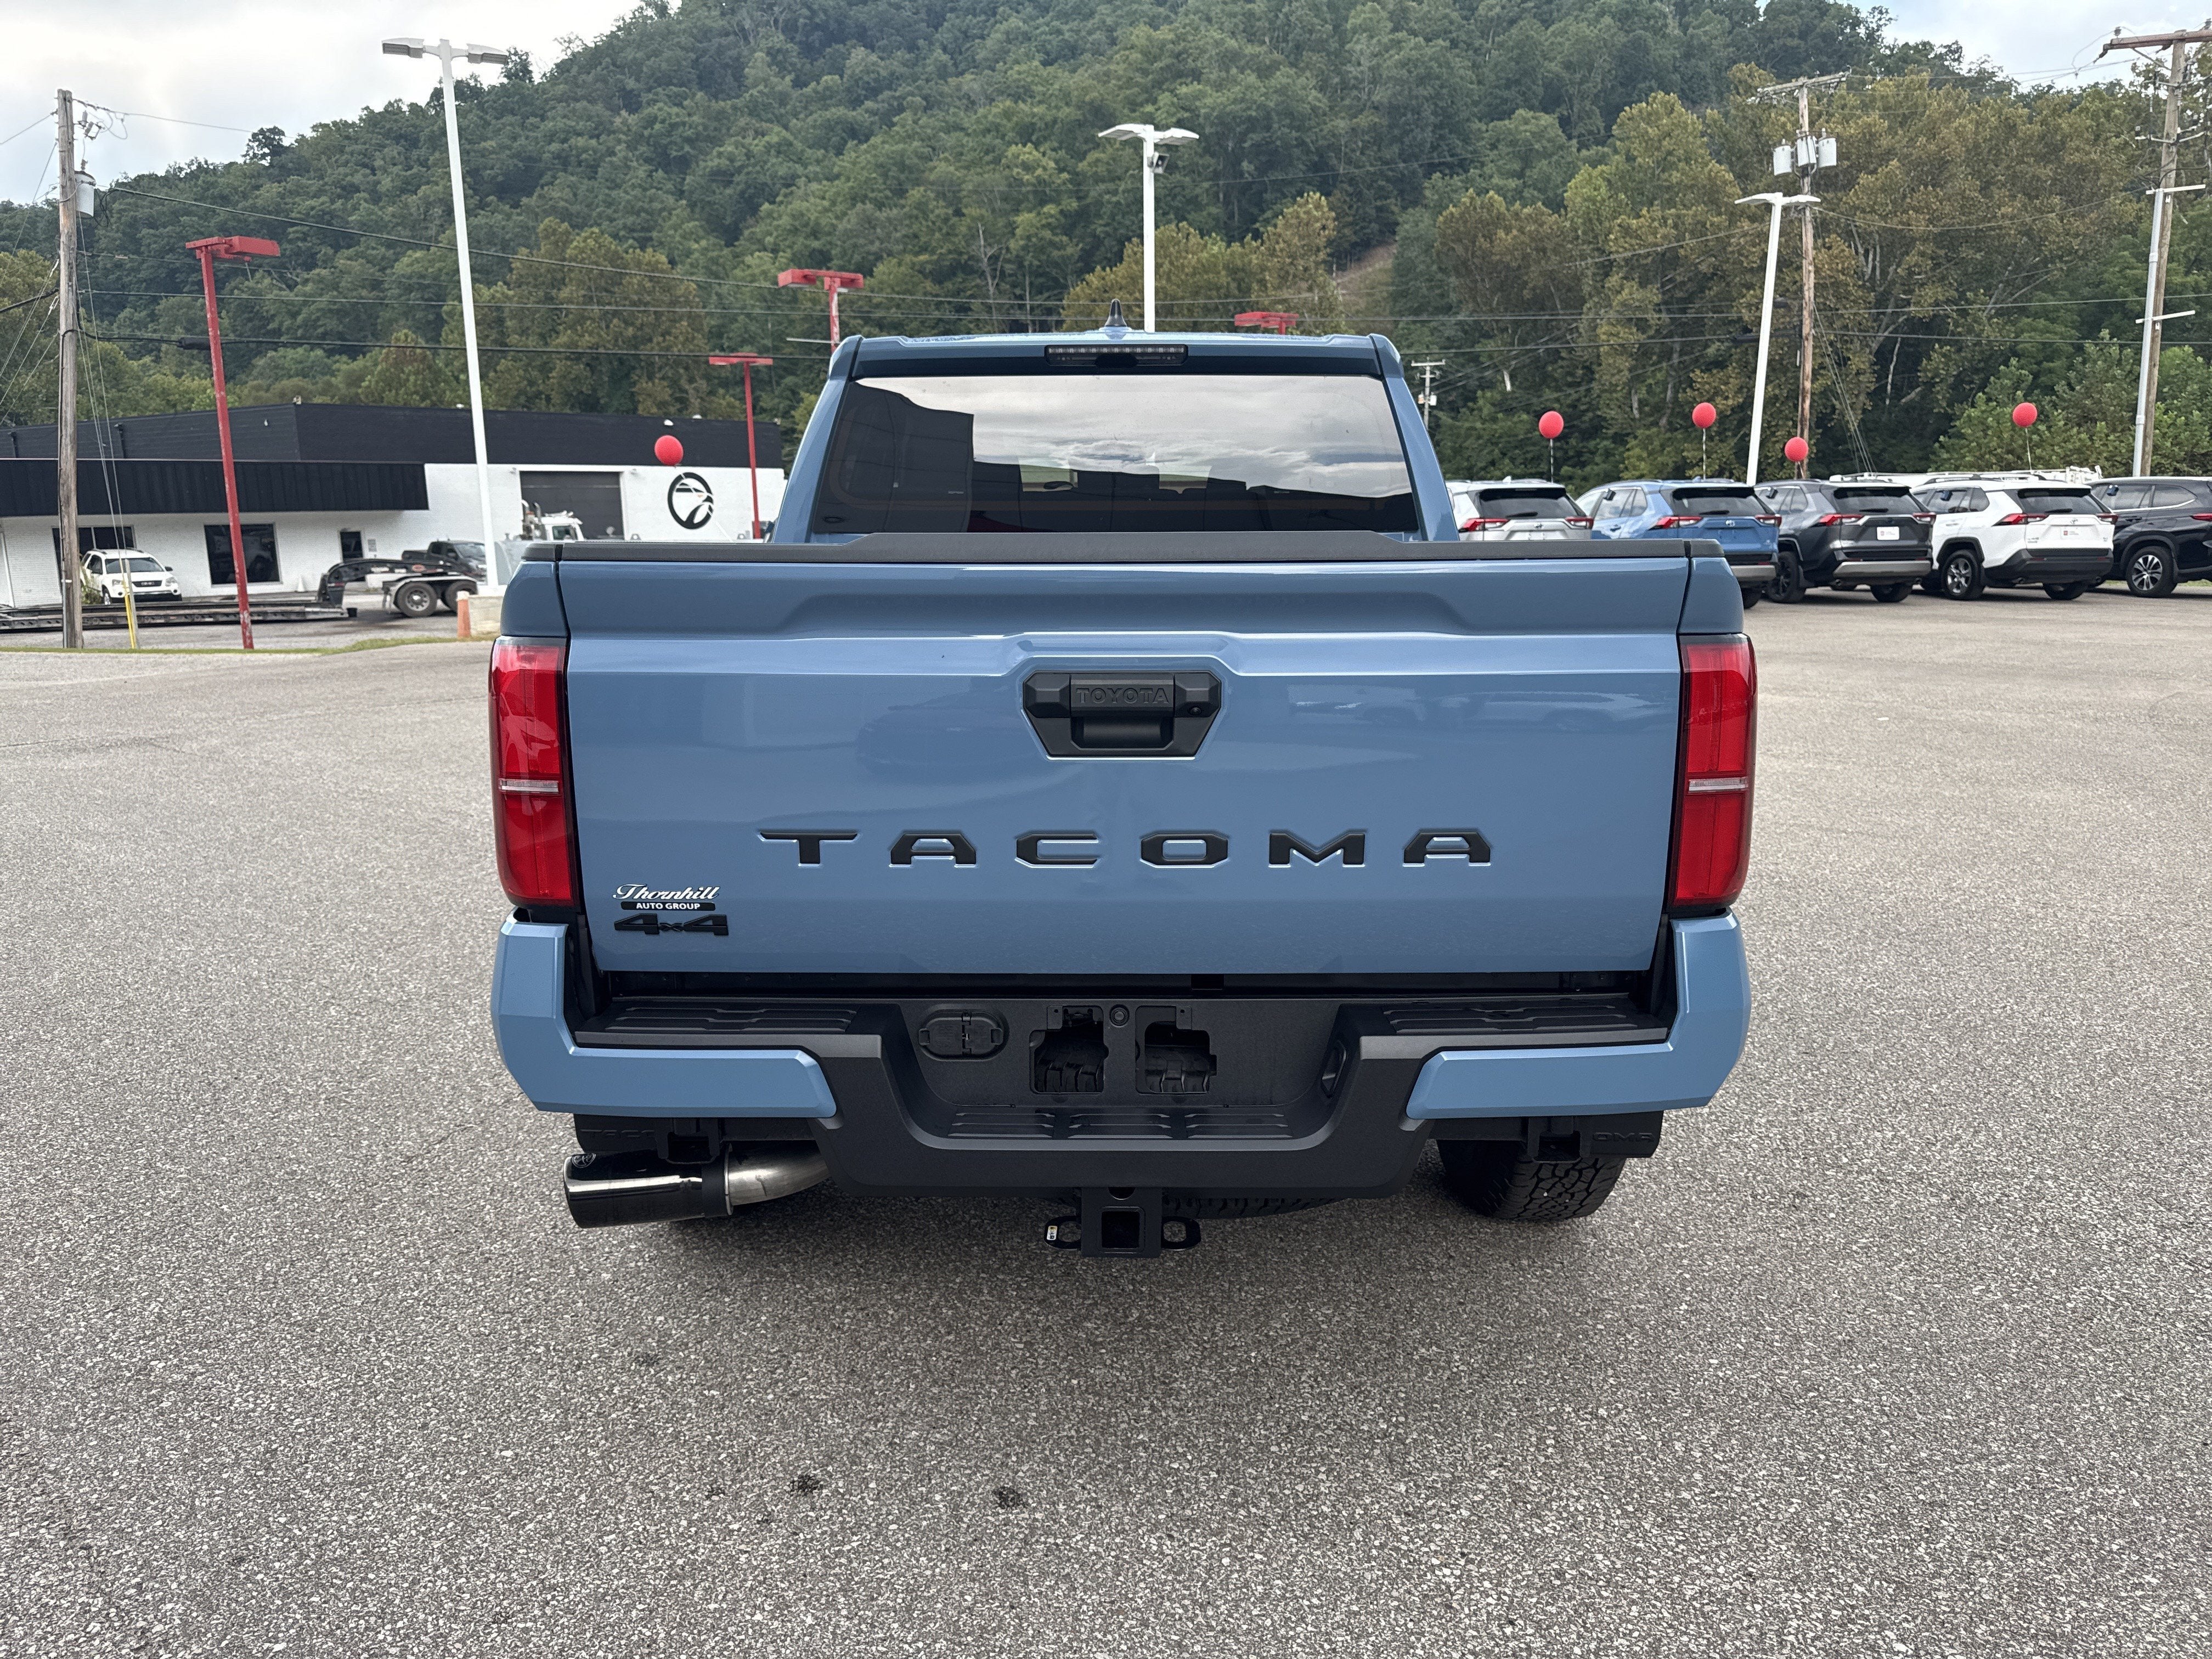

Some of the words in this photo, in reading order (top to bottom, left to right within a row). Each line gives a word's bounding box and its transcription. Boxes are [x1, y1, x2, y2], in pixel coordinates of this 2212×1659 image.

[1076, 687, 1169, 704] TOYOTA
[758, 830, 1491, 868] TACOMA
[612, 883, 720, 900] Thornhill
